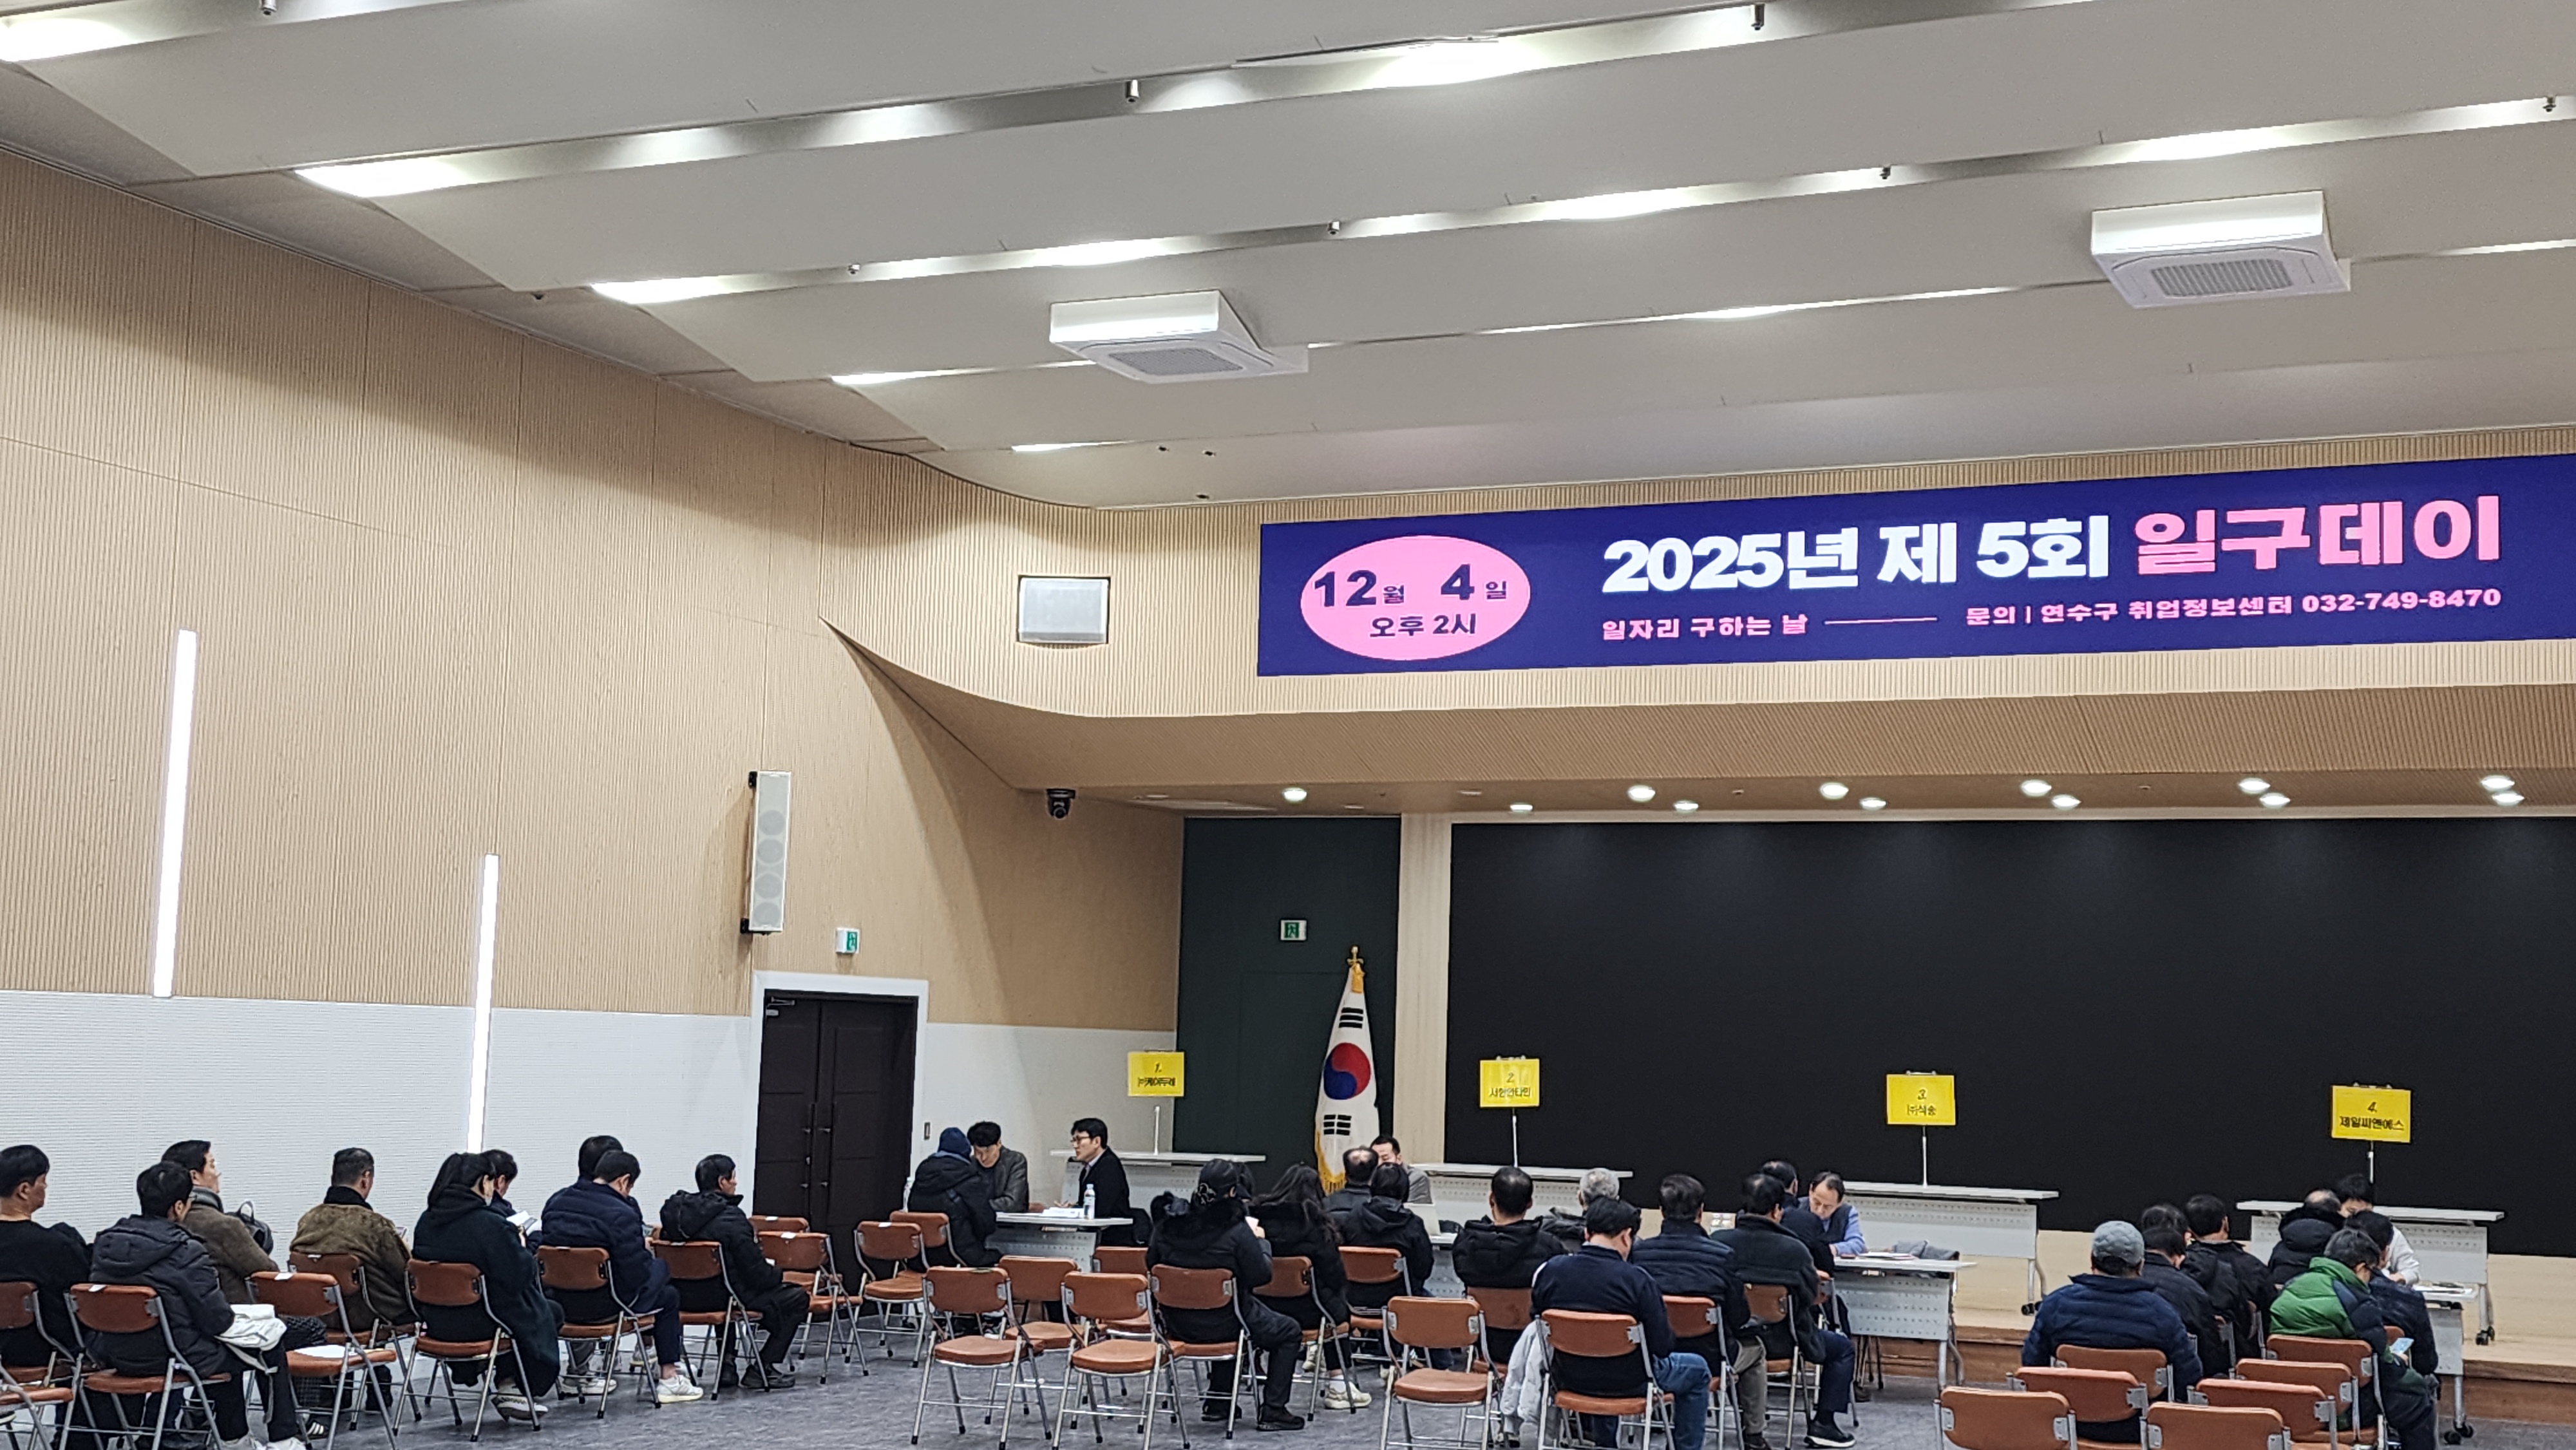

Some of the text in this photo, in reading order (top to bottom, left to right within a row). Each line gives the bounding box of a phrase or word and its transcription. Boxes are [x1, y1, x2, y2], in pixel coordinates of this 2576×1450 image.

[1602, 496, 2499, 592] 2025년 제 5회 일구데이
[1313, 564, 1507, 607] 12월 4일
[1966, 606, 2016, 625] 문의
[2041, 603, 2118, 623] 연수구
[2128, 596, 2291, 619] 취업정보센터
[2302, 588, 2501, 612] 032-749-8470
[1370, 614, 1475, 637] 오후 2시
[1603, 614, 1808, 640] 일자리 구하는 날
[1155, 1062, 1162, 1073] 1.
[2367, 1101, 2378, 1113] 4.
